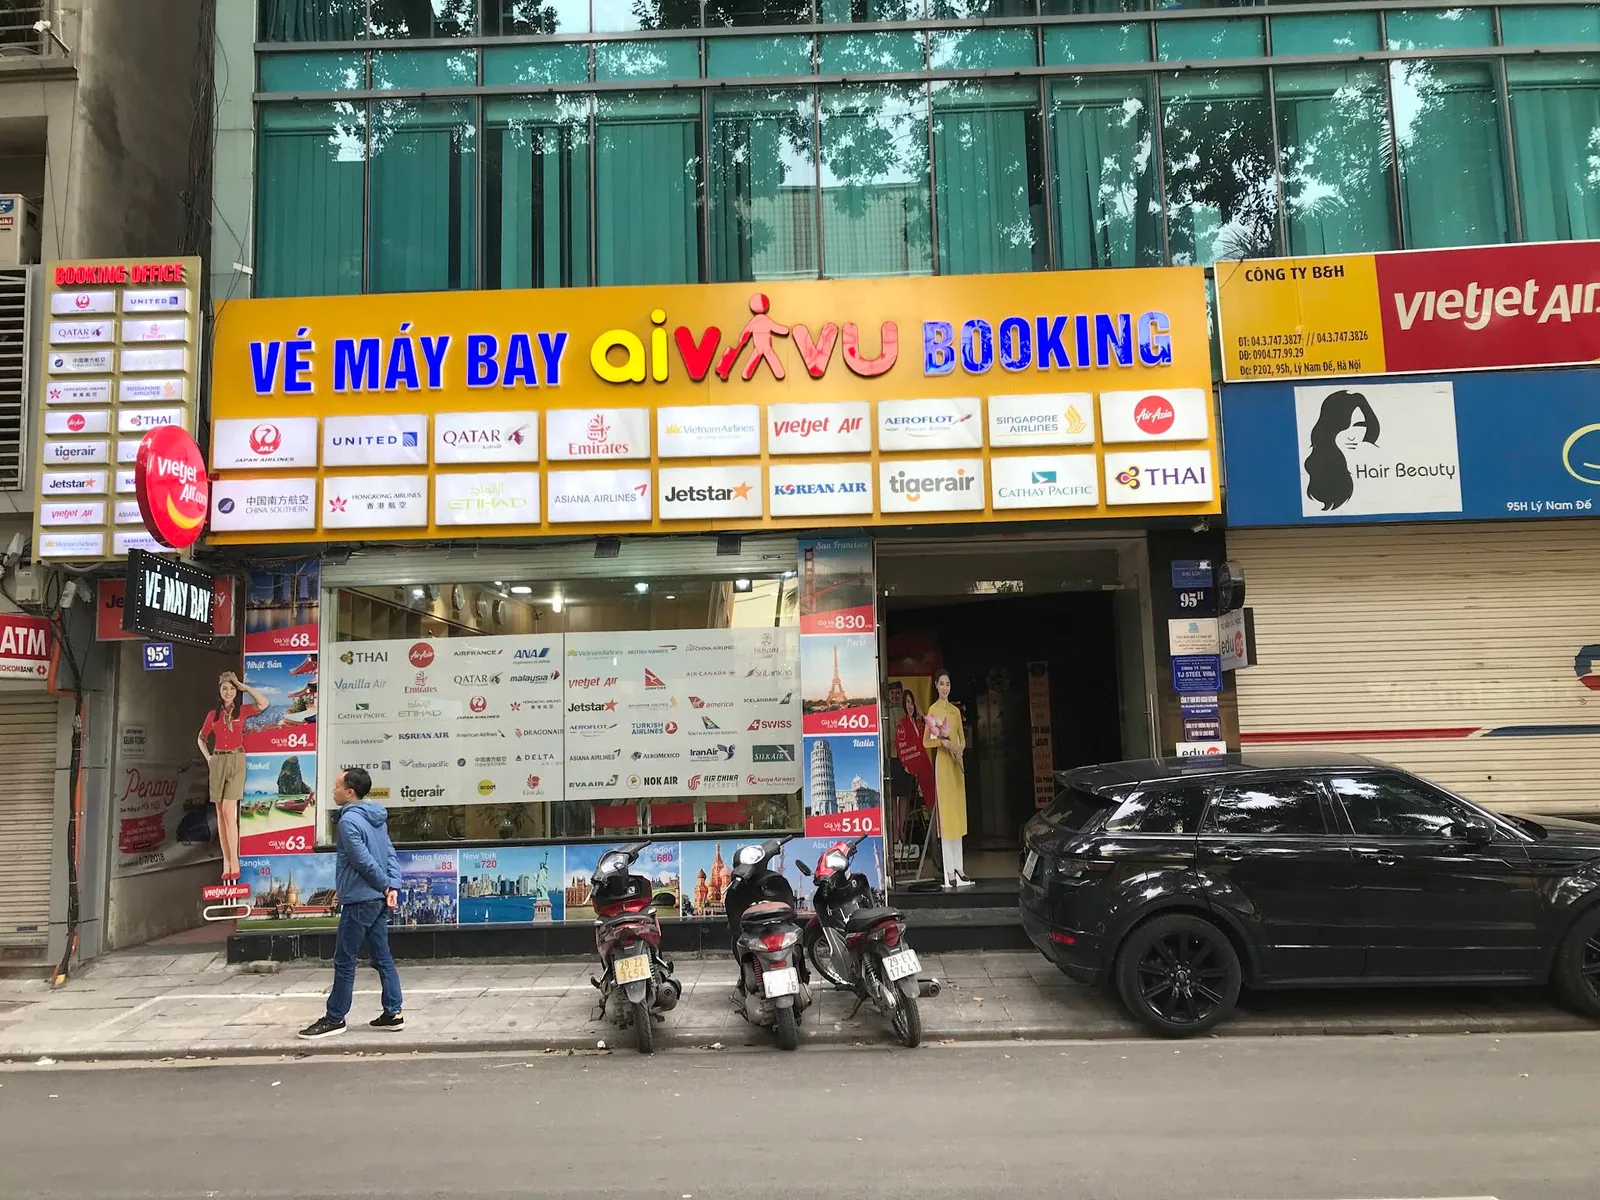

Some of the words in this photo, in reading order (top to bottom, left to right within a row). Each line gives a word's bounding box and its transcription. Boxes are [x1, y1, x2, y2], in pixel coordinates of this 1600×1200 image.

[55, 264, 125, 285] BOOKING
[130, 263, 184, 283] OFFICE
[1245, 266, 1286, 282] CÔNG
[1290, 268, 1308, 280] TY
[1312, 264, 1345, 279] B&H
[58, 328, 90, 338] QATAR
[1238, 336, 1250, 347] ĐT:
[1251, 334, 1302, 347] 04.3.747.3827
[1316, 330, 1369, 344] 04.3.747.3826
[249, 326, 316, 395] VÉ
[333, 321, 452, 392] MÁY
[466, 331, 569, 389] BAY
[922, 311, 1173, 377] BOOKING
[1239, 348, 1251, 360] DĐ:
[1252, 347, 1304, 360] 0904.77.99.29
[1252, 364, 1274, 376] P202,
[1276, 363, 1293, 375] 95h,
[1294, 362, 1302, 375] Lý
[1304, 362, 1322, 373] Nam
[1322, 360, 1336, 373] Đế,
[1337, 360, 1348, 371] Hà
[1348, 359, 1362, 372] Nội
[144, 416, 172, 425] THAI
[884, 416, 954, 424] AEROFLOT
[996, 415, 1058, 425] SINGAPORE
[1008, 422, 1058, 433] AIRLINES
[332, 436, 398, 446] UNITED
[443, 429, 500, 446] QATAR
[55, 444, 96, 460] tigerair
[568, 442, 628, 456] Emirates
[1144, 466, 1206, 486] THAI
[1356, 463, 1390, 480] Hair
[1396, 462, 1456, 480] Beauty
[50, 479, 86, 488] Jetstar
[774, 483, 834, 496] KOREAN
[838, 481, 867, 494] AIR
[889, 468, 975, 502] tigerair
[665, 485, 733, 502] Jetstar
[998, 486, 1046, 498] CATHAY
[1048, 485, 1092, 496] PACIFIC
[246, 494, 309, 506] 中国南方航空
[447, 497, 527, 510] ETIHAD
[554, 494, 590, 504] ASIANA
[593, 492, 636, 502] AIRLINES
[270, 505, 308, 513] SOUTHERN
[1506, 501, 1528, 512] 95H
[1530, 500, 1544, 513] Lý
[1546, 500, 1573, 511] Nam
[1575, 498, 1592, 511] Đế
[816, 542, 830, 550] San
[833, 541, 869, 549] Francisco
[145, 565, 162, 610] VÉ
[162, 572, 189, 616] MÁY
[190, 585, 210, 624] BAY
[835, 615, 866, 629] 830
[0, 626, 46, 656] ATM
[290, 633, 310, 647] 68
[356, 652, 388, 662] THAI
[514, 649, 538, 659] ANA
[0, 664, 34, 673] ECHCOMBANK
[246, 660, 265, 671] Nhật
[266, 660, 282, 669] Bản
[334, 678, 370, 690] Vanilla
[372, 680, 387, 688] Air
[454, 675, 488, 685] QATAR
[510, 675, 548, 684] malaysia
[568, 702, 605, 712] Jetstar
[398, 710, 442, 718] ETIHAD
[762, 720, 792, 729] SWISS
[838, 714, 869, 728] 460
[288, 733, 308, 748] 84
[852, 738, 875, 748] Italia
[644, 777, 662, 786] NOK
[664, 776, 678, 784] AIR
[120, 768, 178, 807] Penang
[400, 784, 445, 802] tigerair
[841, 817, 873, 832] 510
[285, 836, 306, 851] 63
[812, 840, 828, 849] Abu
[412, 853, 430, 862] Hong
[432, 852, 452, 862] Kong
[657, 853, 673, 862] 680
[239, 860, 271, 870] Bangkok
[441, 862, 452, 870] 83
[481, 860, 497, 868] 720
